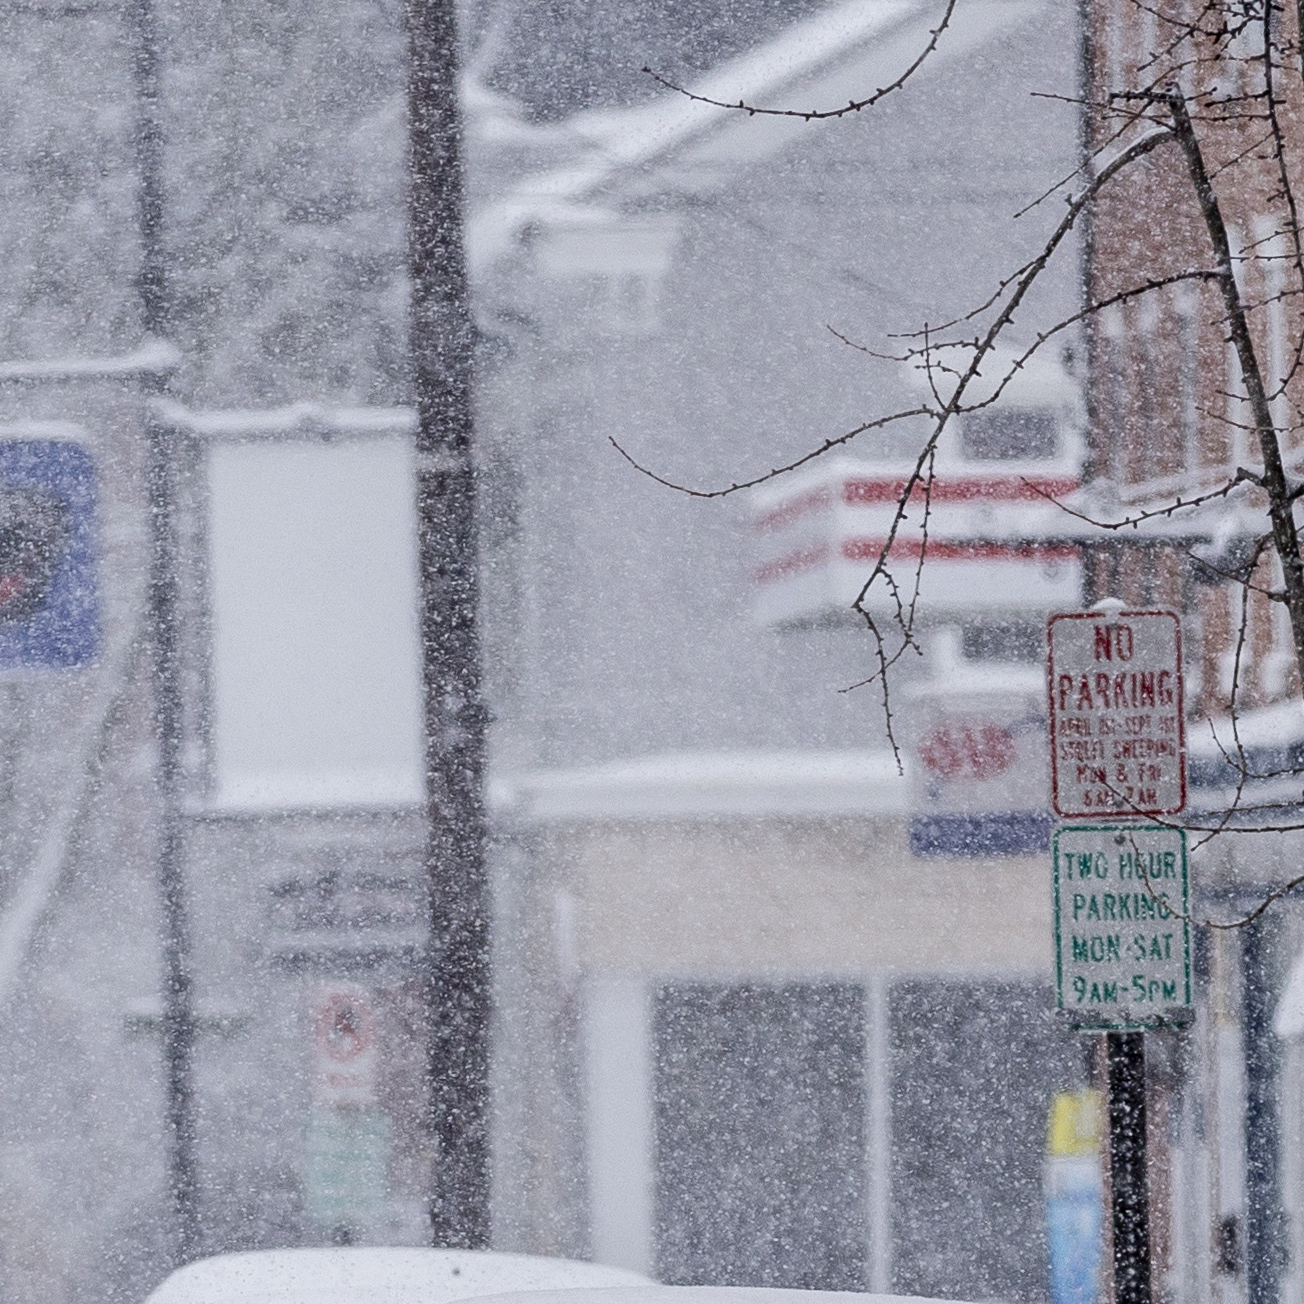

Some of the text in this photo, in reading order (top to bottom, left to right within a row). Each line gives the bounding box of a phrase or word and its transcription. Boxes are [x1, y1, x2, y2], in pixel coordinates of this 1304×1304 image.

[1094, 623, 1133, 662] NO
[1059, 670, 1173, 710] PARKING
[1060, 737, 1176, 760] STREET SWEEPING
[1076, 763, 1162, 783] MON & FRI
[1064, 850, 1176, 880] TWO HOUR
[1073, 892, 1170, 922] PARKING
[1072, 974, 1176, 1004] 9AM-5PM
